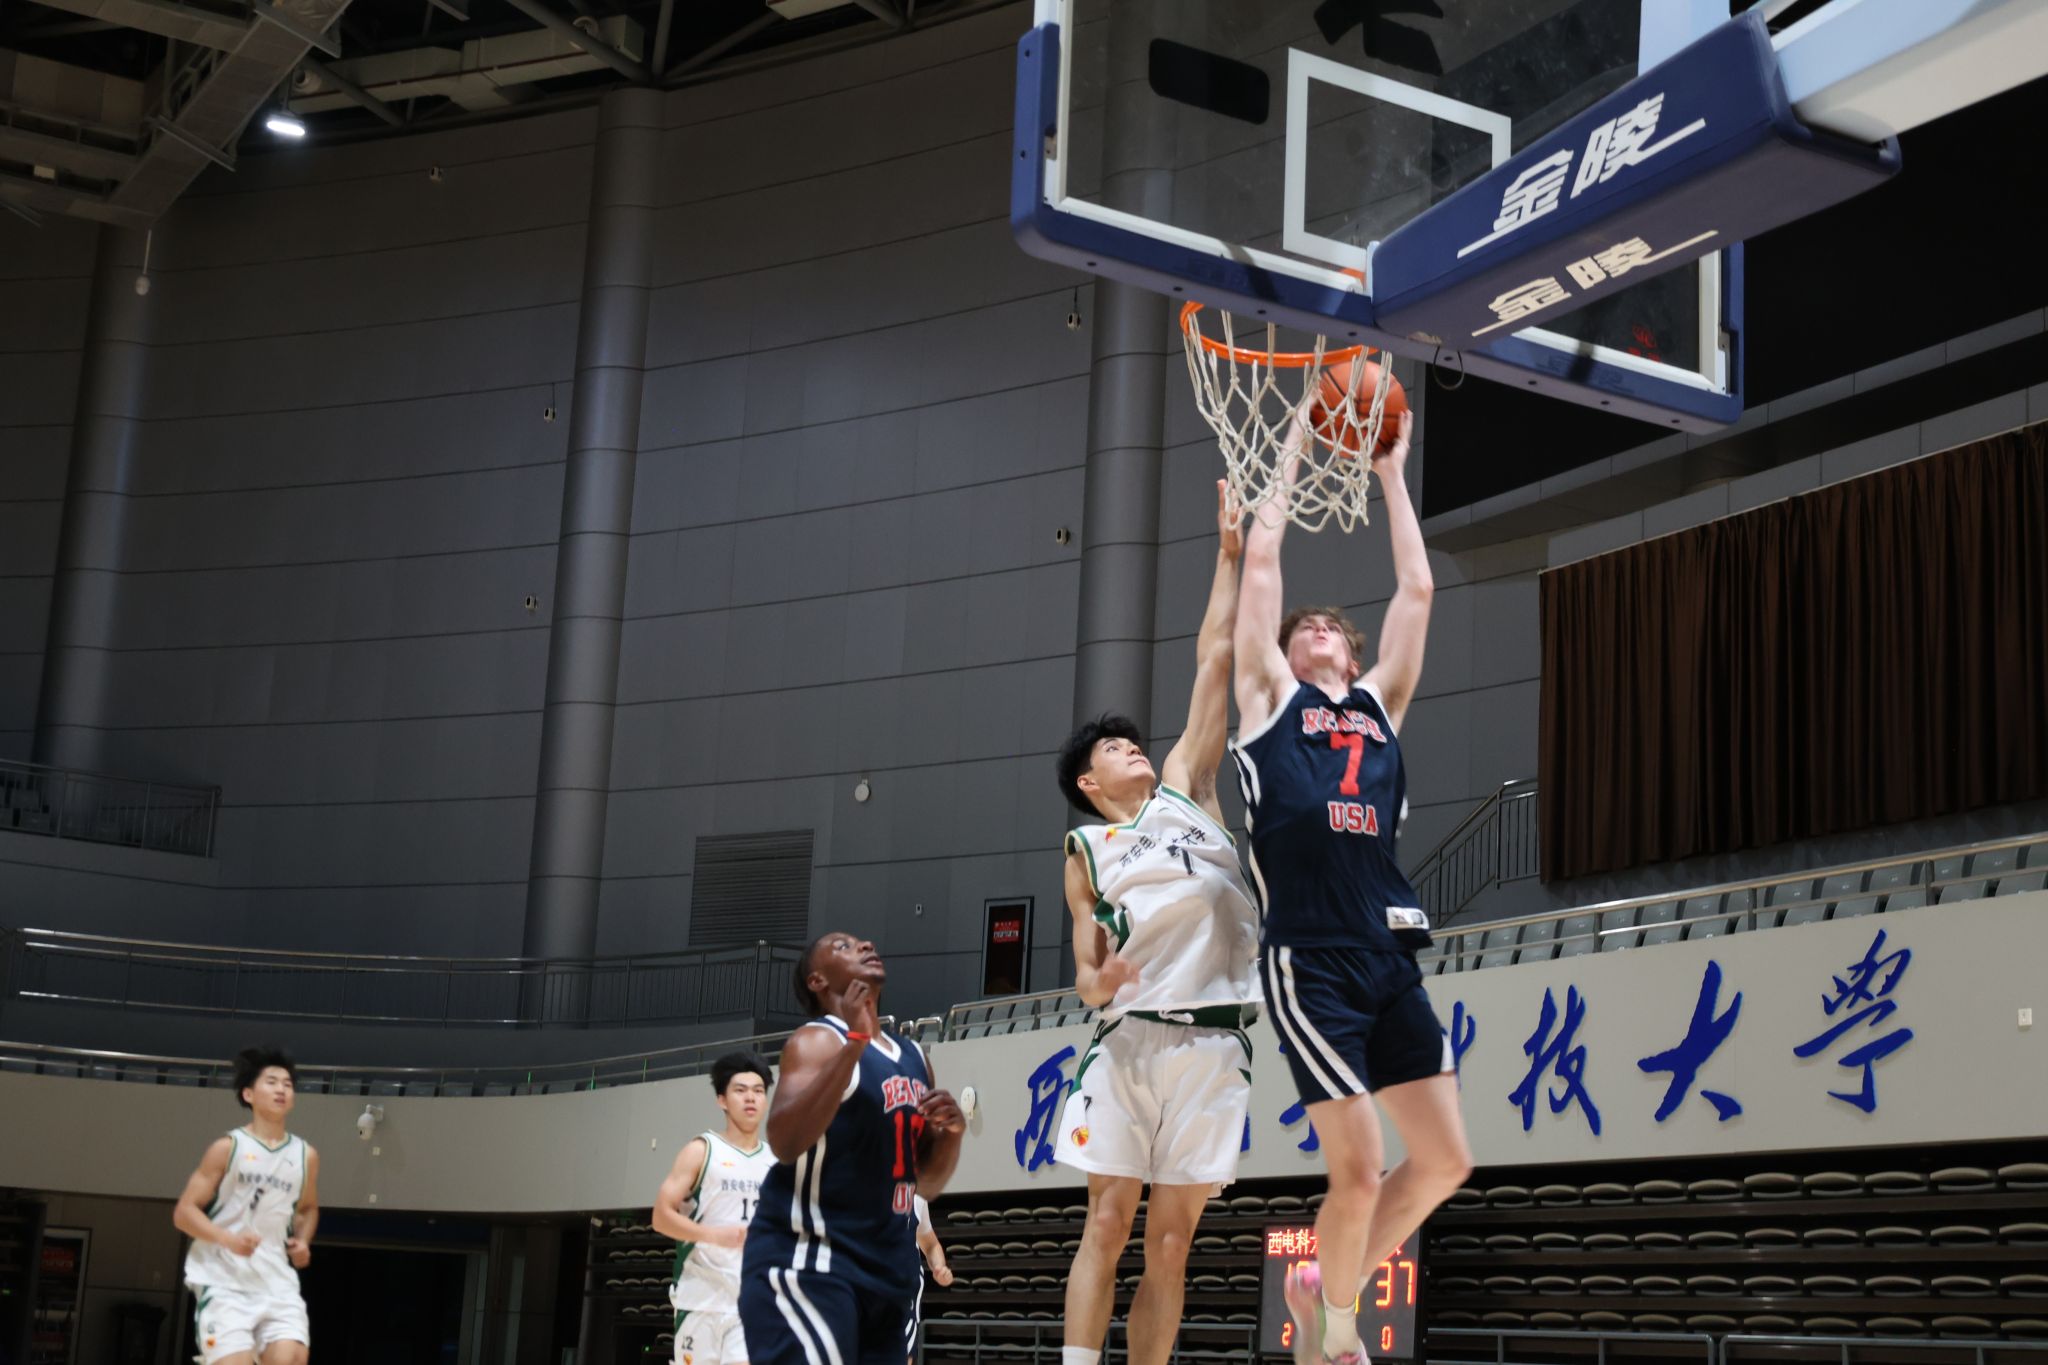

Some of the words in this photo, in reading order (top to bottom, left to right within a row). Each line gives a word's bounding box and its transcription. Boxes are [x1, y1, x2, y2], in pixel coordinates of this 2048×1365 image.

[1457, 91, 1706, 259] 金陵
[1330, 731, 1364, 796] 7
[1327, 801, 1379, 837] USA
[1375, 1260, 1414, 1307] 37
[1380, 1325, 1392, 1351] 0
